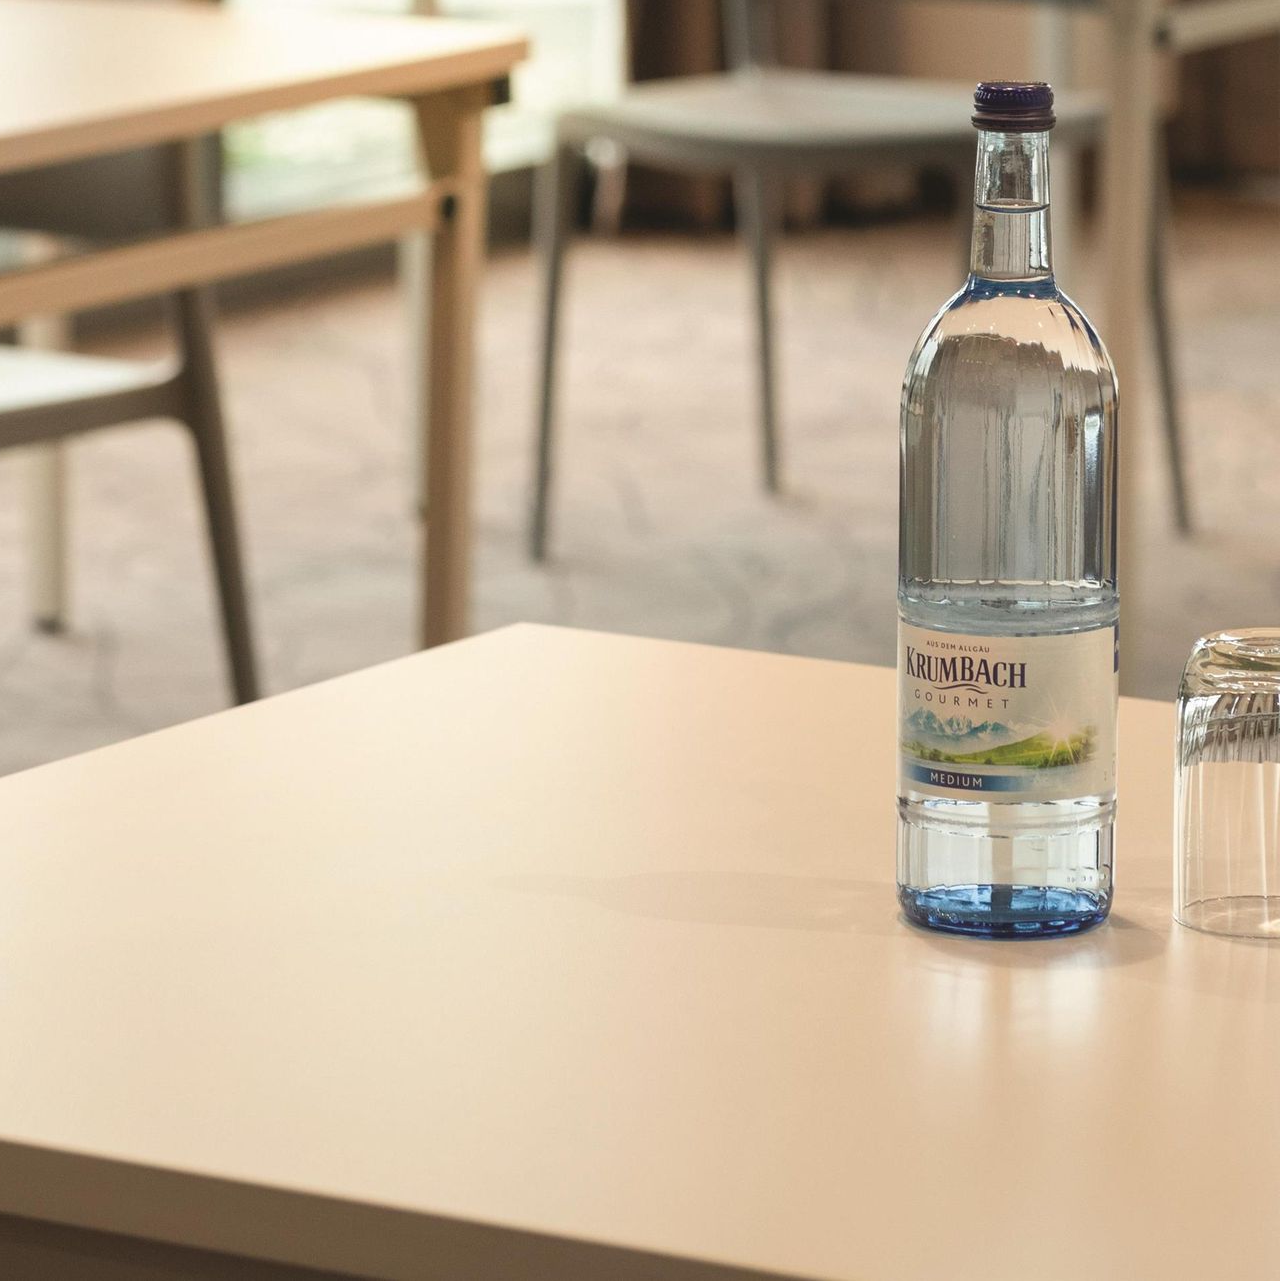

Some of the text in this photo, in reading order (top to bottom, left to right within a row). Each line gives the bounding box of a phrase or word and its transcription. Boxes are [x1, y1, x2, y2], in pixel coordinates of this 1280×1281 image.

[926, 640, 990, 653] AUS DEM ALLGÄU
[906, 646, 1027, 689] KRUMBACH
[914, 688, 1009, 709] GOURMET
[930, 771, 983, 789] MEDIUM
